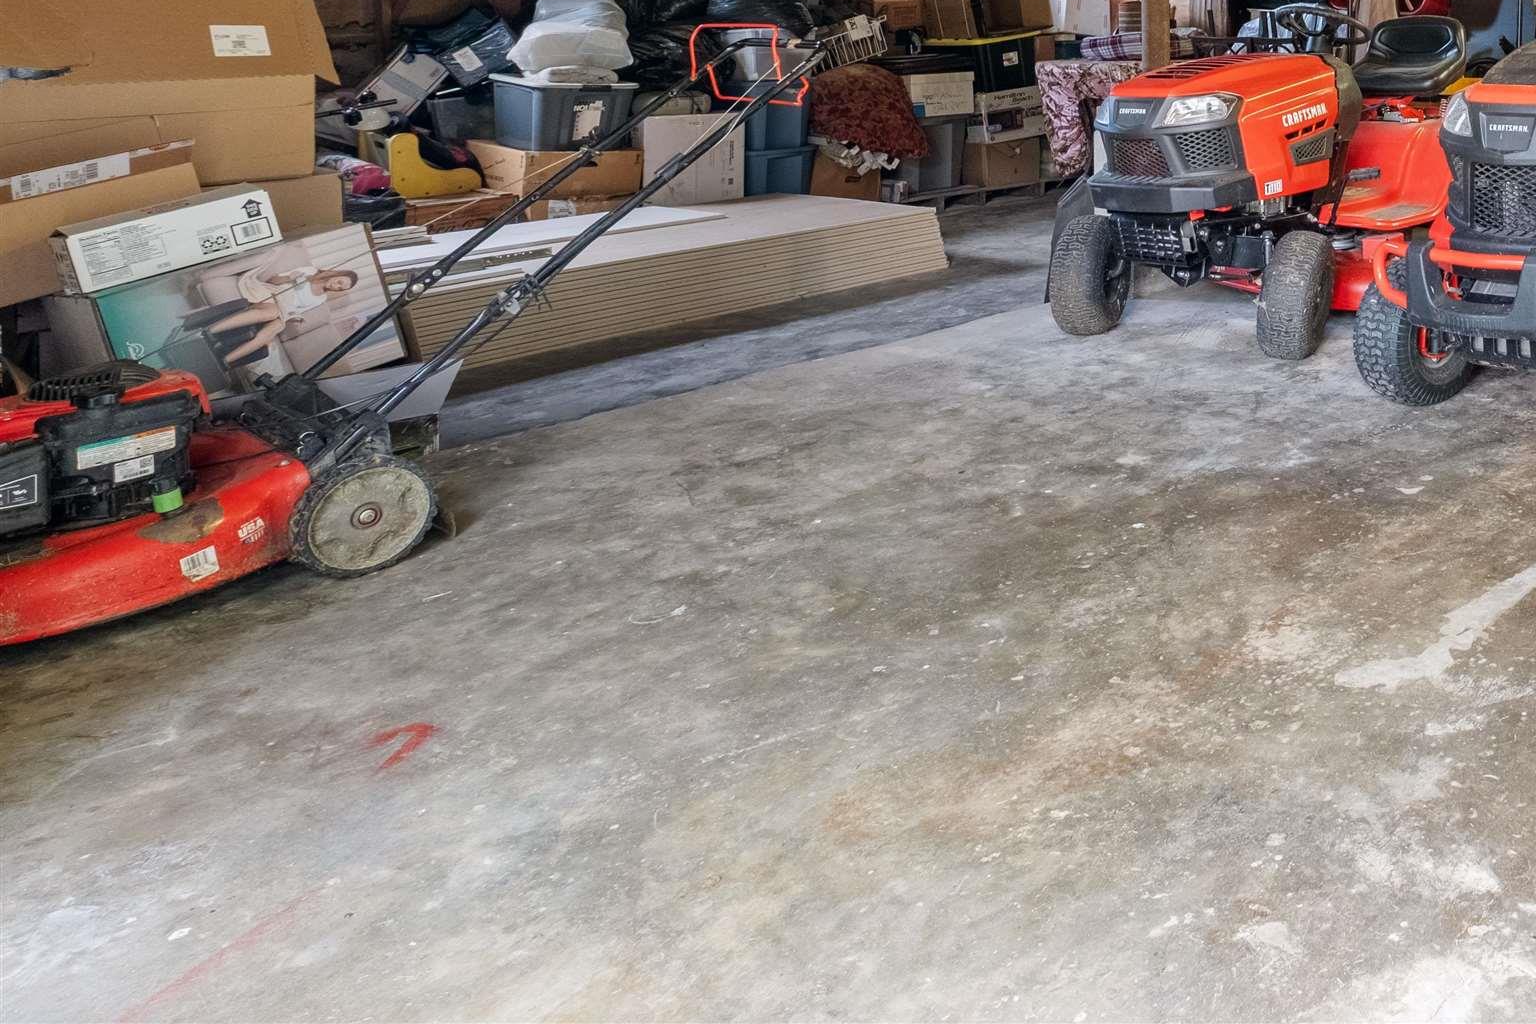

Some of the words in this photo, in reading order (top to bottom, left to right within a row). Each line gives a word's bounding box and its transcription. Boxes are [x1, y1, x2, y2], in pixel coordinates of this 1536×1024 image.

[1119, 107, 1147, 115] CRAFTSMAN
[1281, 102, 1329, 128] CRAFTSMAN
[1489, 123, 1529, 133] CRAFTSMAN
[237, 517, 265, 538] USA
